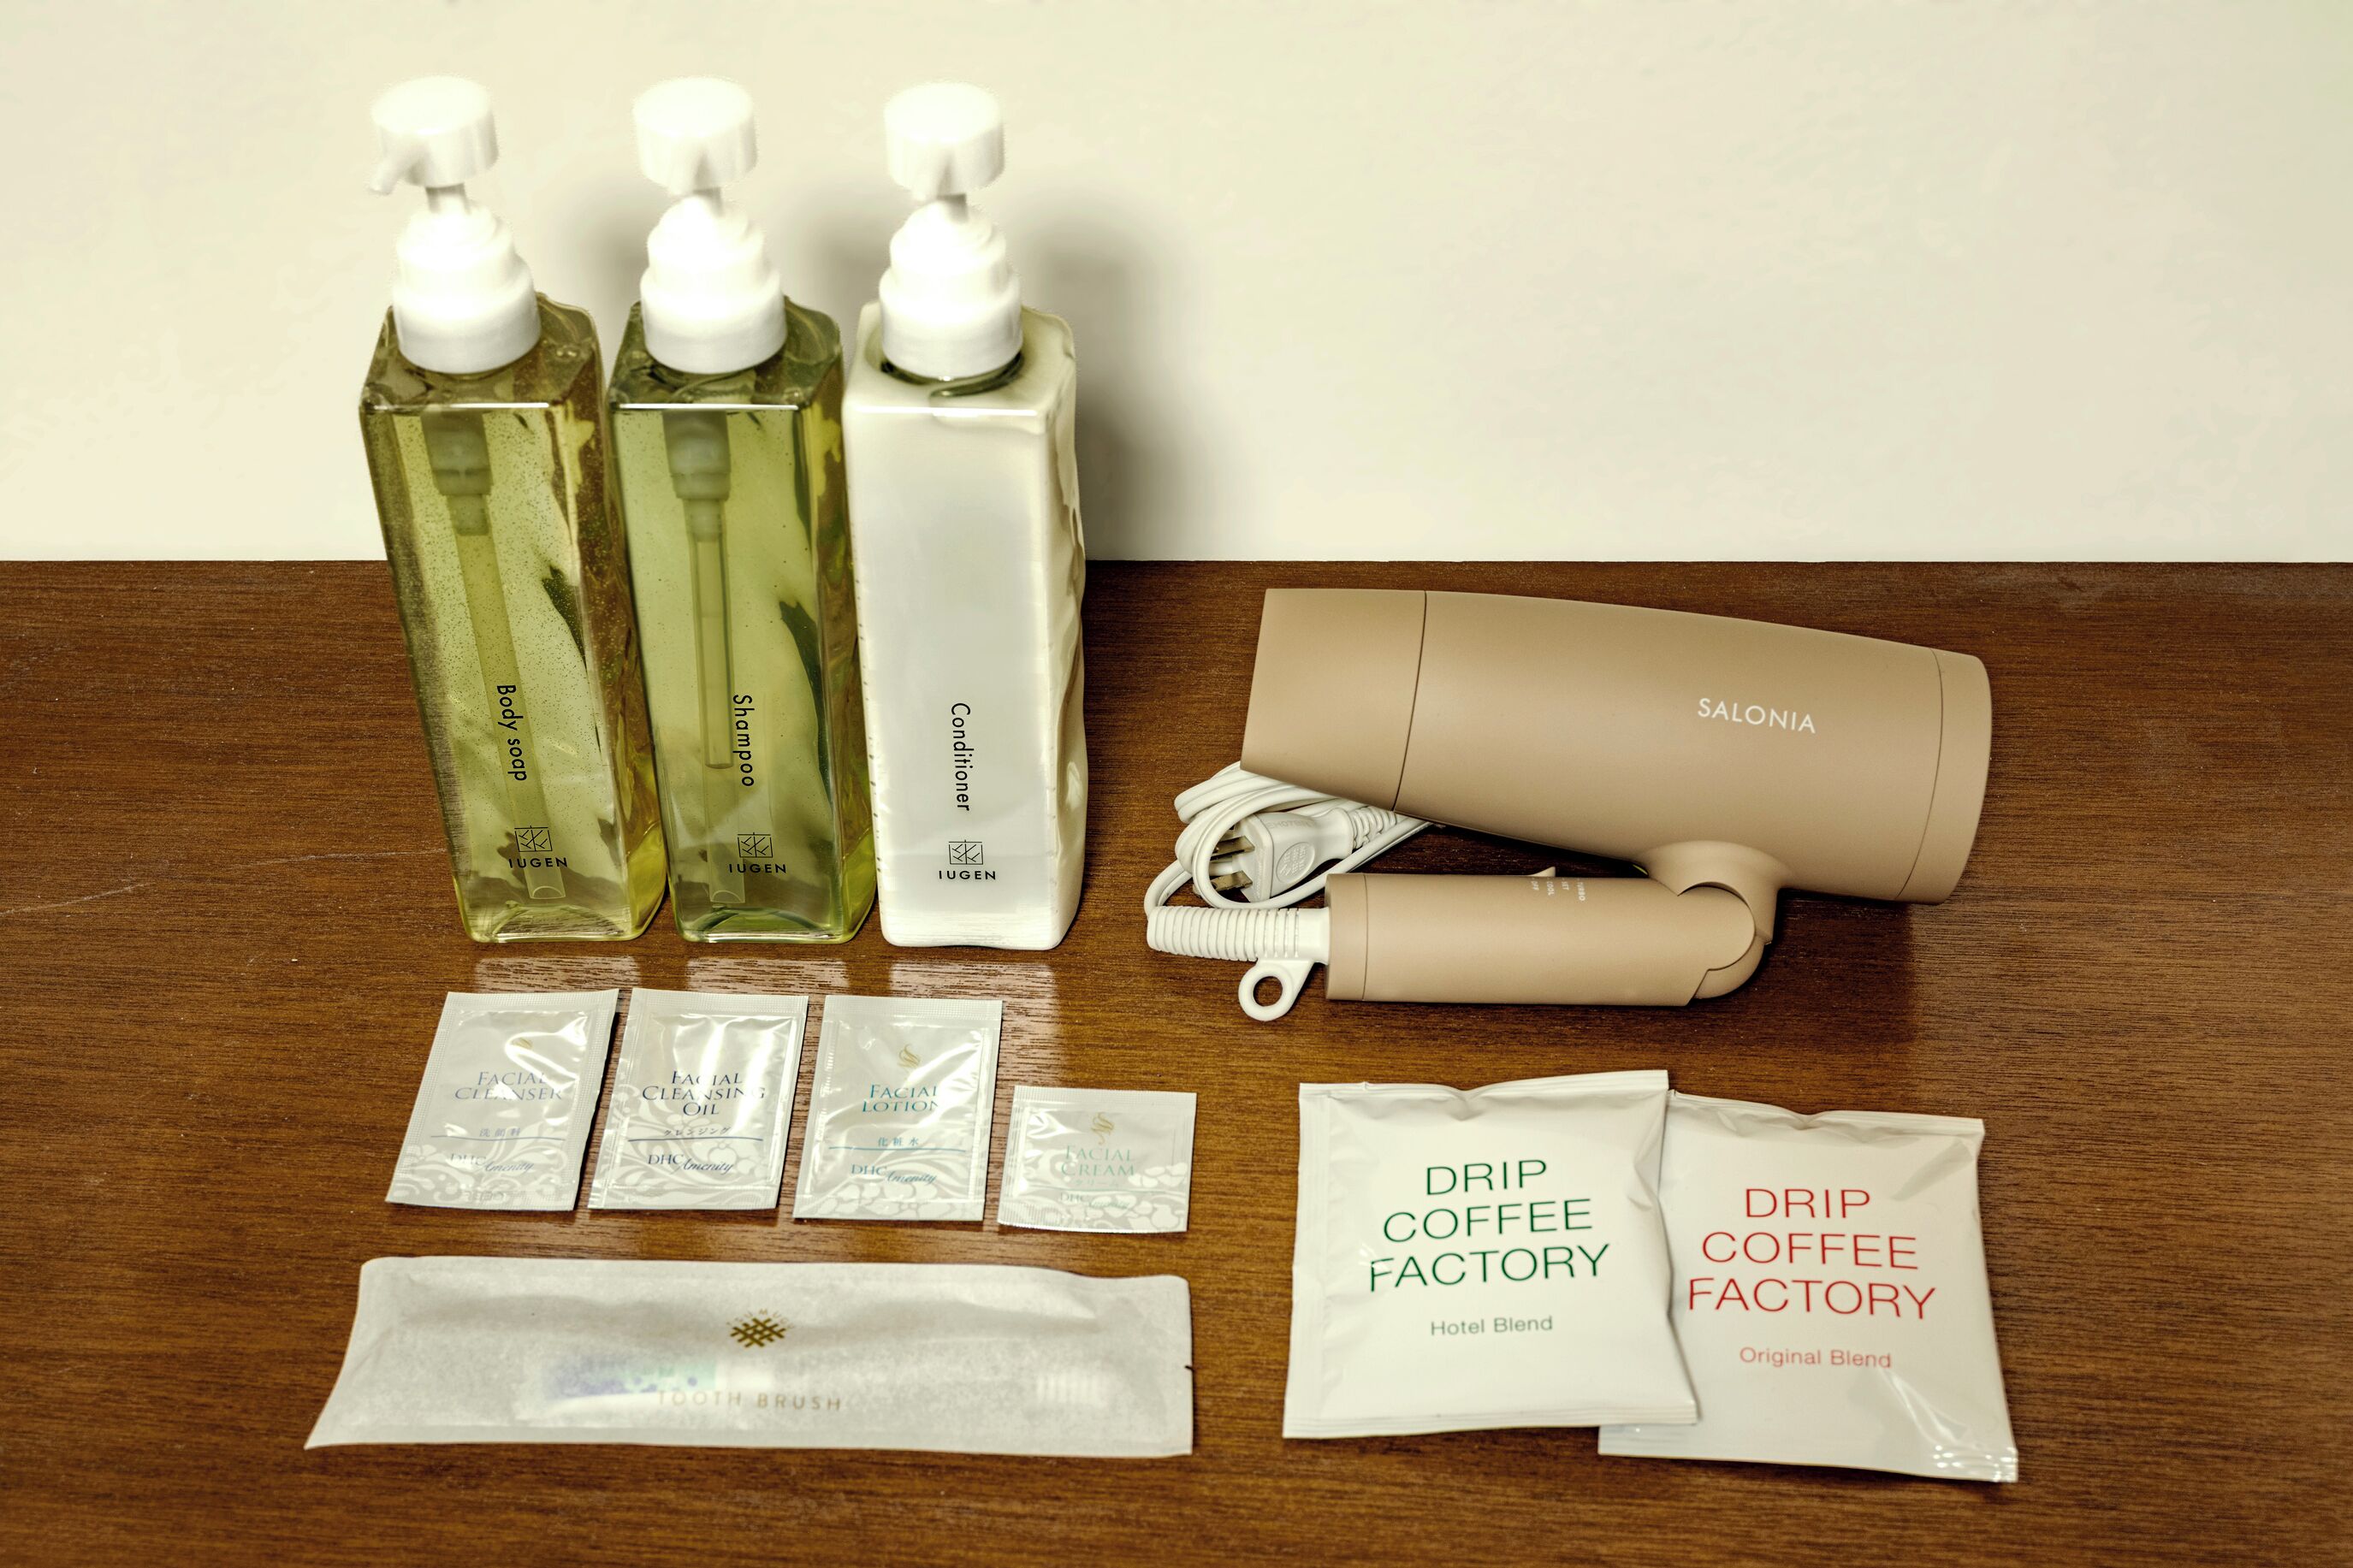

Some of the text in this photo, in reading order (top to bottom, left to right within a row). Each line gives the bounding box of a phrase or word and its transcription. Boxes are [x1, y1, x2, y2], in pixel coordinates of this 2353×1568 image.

[1698, 697, 1816, 734] SALONIA
[497, 684, 527, 781] Body soap
[732, 695, 755, 786] Shampoo
[951, 703, 974, 811] Conditioner
[508, 857, 567, 868] IUGEN
[729, 863, 786, 873] IUGEN
[939, 870, 996, 880] IUGEN
[477, 1071, 547, 1086] FACIAL
[454, 1087, 562, 1101] CLENSER
[643, 1086, 766, 1101] CLEANSING
[683, 1102, 720, 1115] OIL
[862, 1100, 939, 1112] LOTION
[878, 1137, 919, 1147] 化粧水
[1065, 1145, 1134, 1161] FACIAL
[648, 1154, 734, 1175] DHC Amenity
[851, 1164, 937, 1185] DHC Amenity
[1061, 1163, 1135, 1176] CREAM
[1426, 1159, 1547, 1196] DRIP
[1060, 1192, 1088, 1202] DHC
[1745, 1188, 1870, 1218] DRIP
[1384, 1198, 1592, 1243] COFFEE
[1702, 1231, 1918, 1269] COFFEE
[1371, 1243, 1609, 1292] FACTORY
[1689, 1277, 1936, 1320] FACTORY
[1431, 1316, 1553, 1335] Hotel Blend
[1740, 1346, 1891, 1368] Original Blend
[657, 1390, 841, 1411] TOOTH BRUSH
